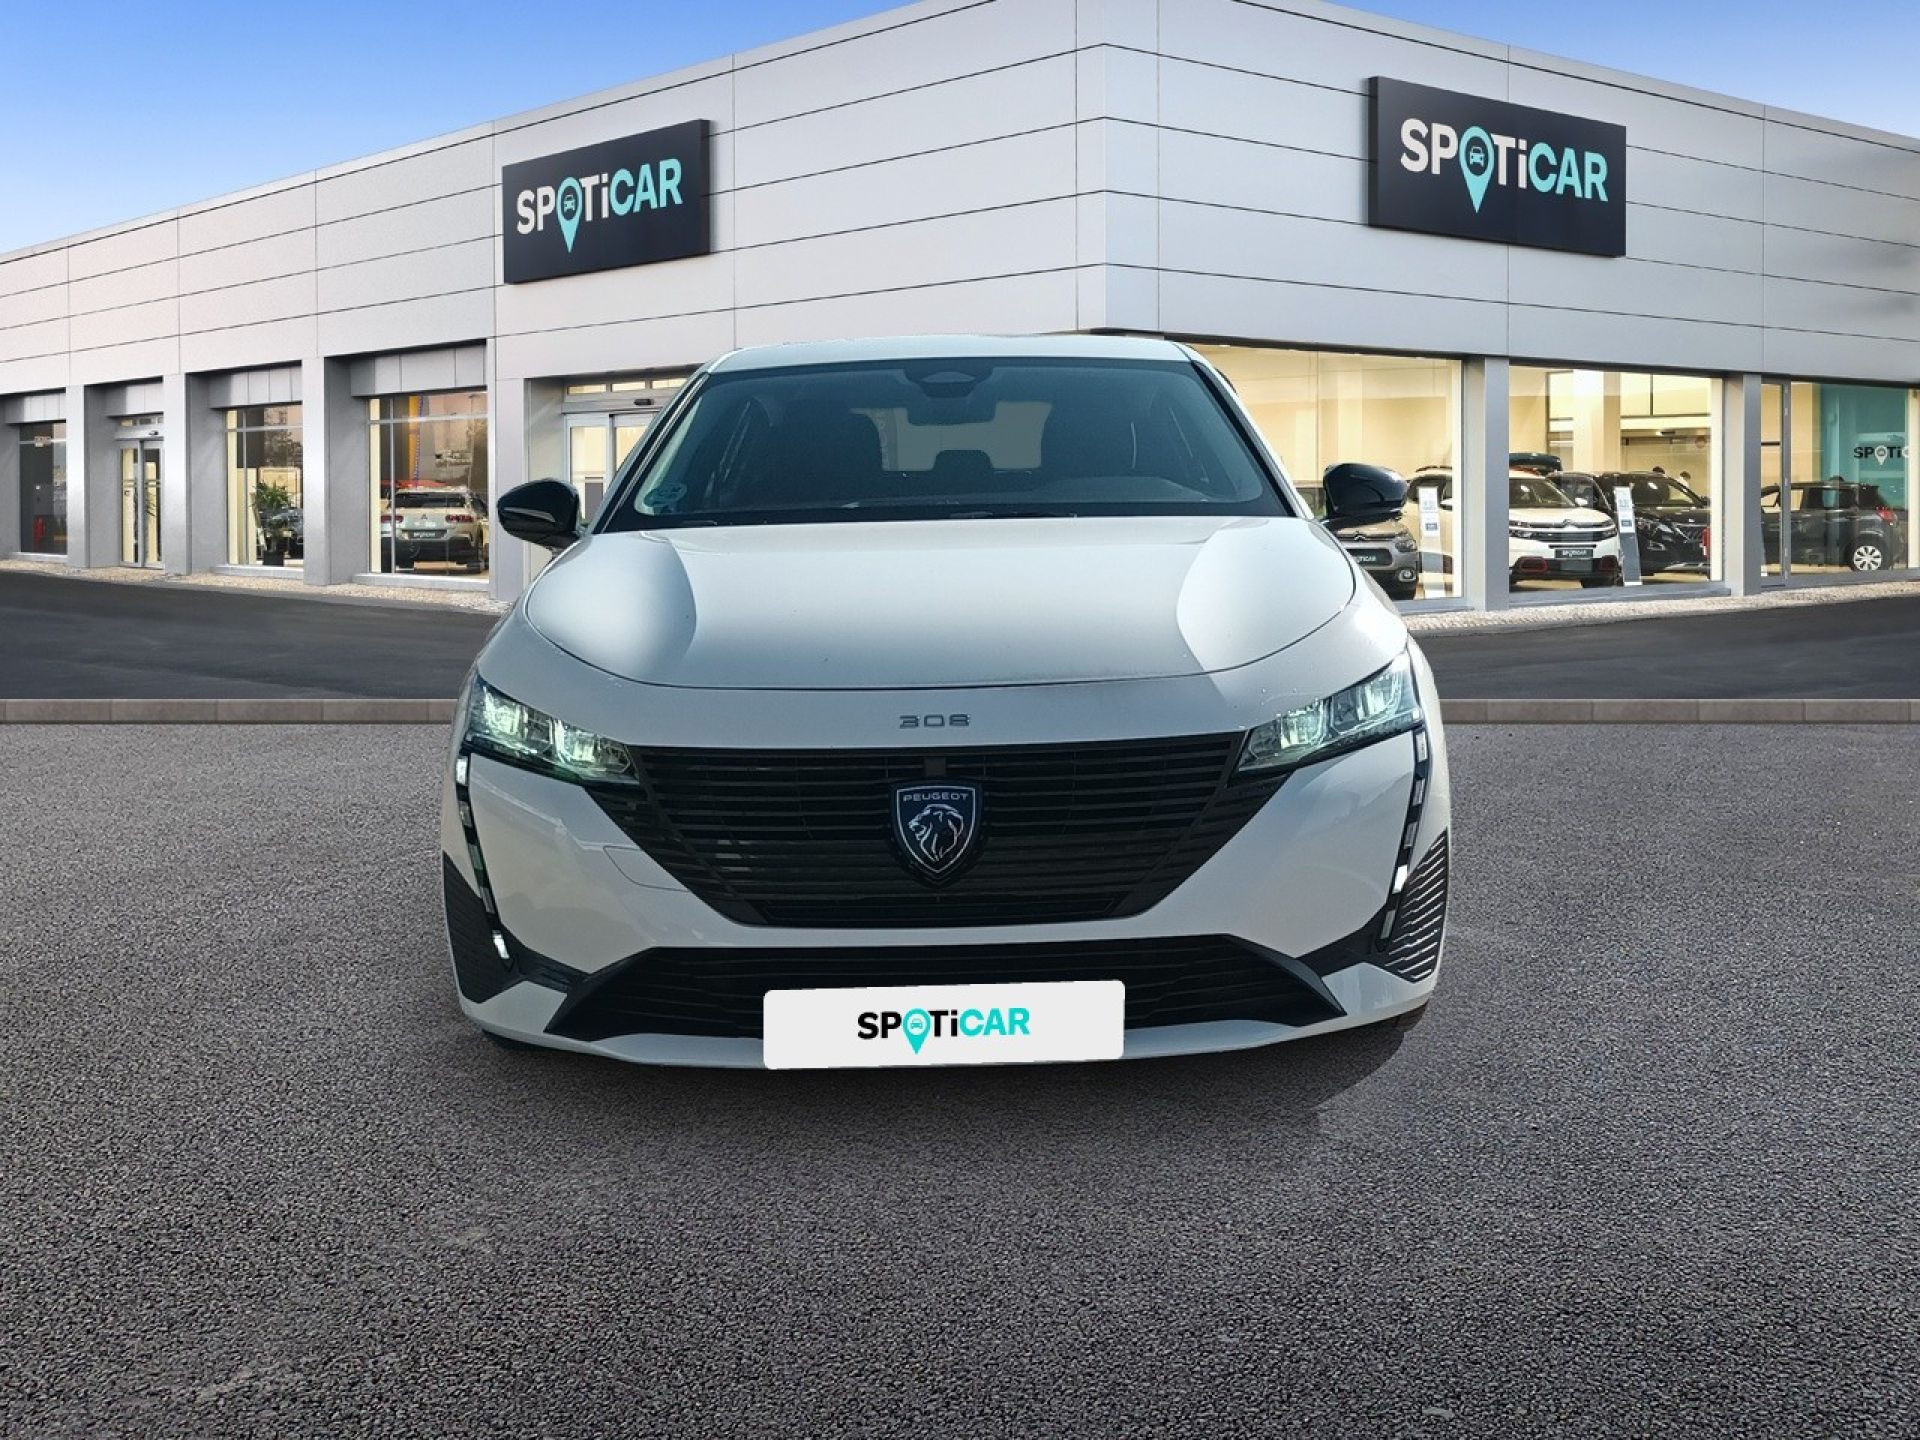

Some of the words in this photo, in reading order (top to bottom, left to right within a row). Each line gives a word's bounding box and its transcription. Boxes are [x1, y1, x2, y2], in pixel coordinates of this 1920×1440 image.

[1400, 118, 1608, 213] SPOTiCAR
[516, 158, 683, 253] SPOTiCAR
[899, 713, 970, 728] 308
[903, 792, 969, 802] PEUGEOT
[857, 1007, 1031, 1055] SPOTiCAR
